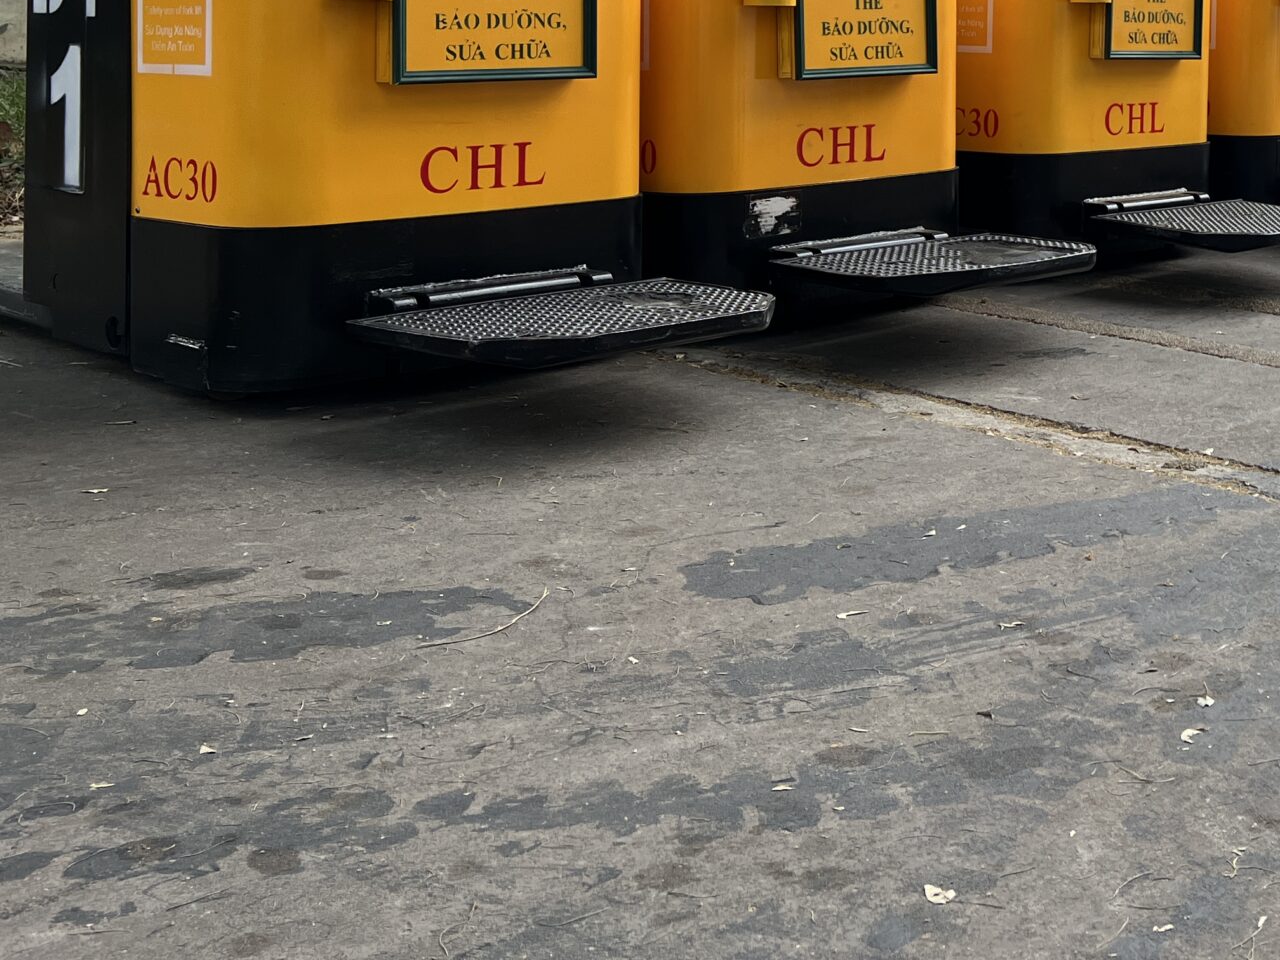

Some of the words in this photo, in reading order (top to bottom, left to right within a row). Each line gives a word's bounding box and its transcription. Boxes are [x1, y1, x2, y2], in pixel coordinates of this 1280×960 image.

[494, 39, 552, 60] CHỮA
[50, 44, 81, 189] 1
[1104, 102, 1165, 135] CHL
[420, 142, 546, 194] CHL
[796, 124, 886, 167] CHL
[142, 155, 218, 203] AC30
